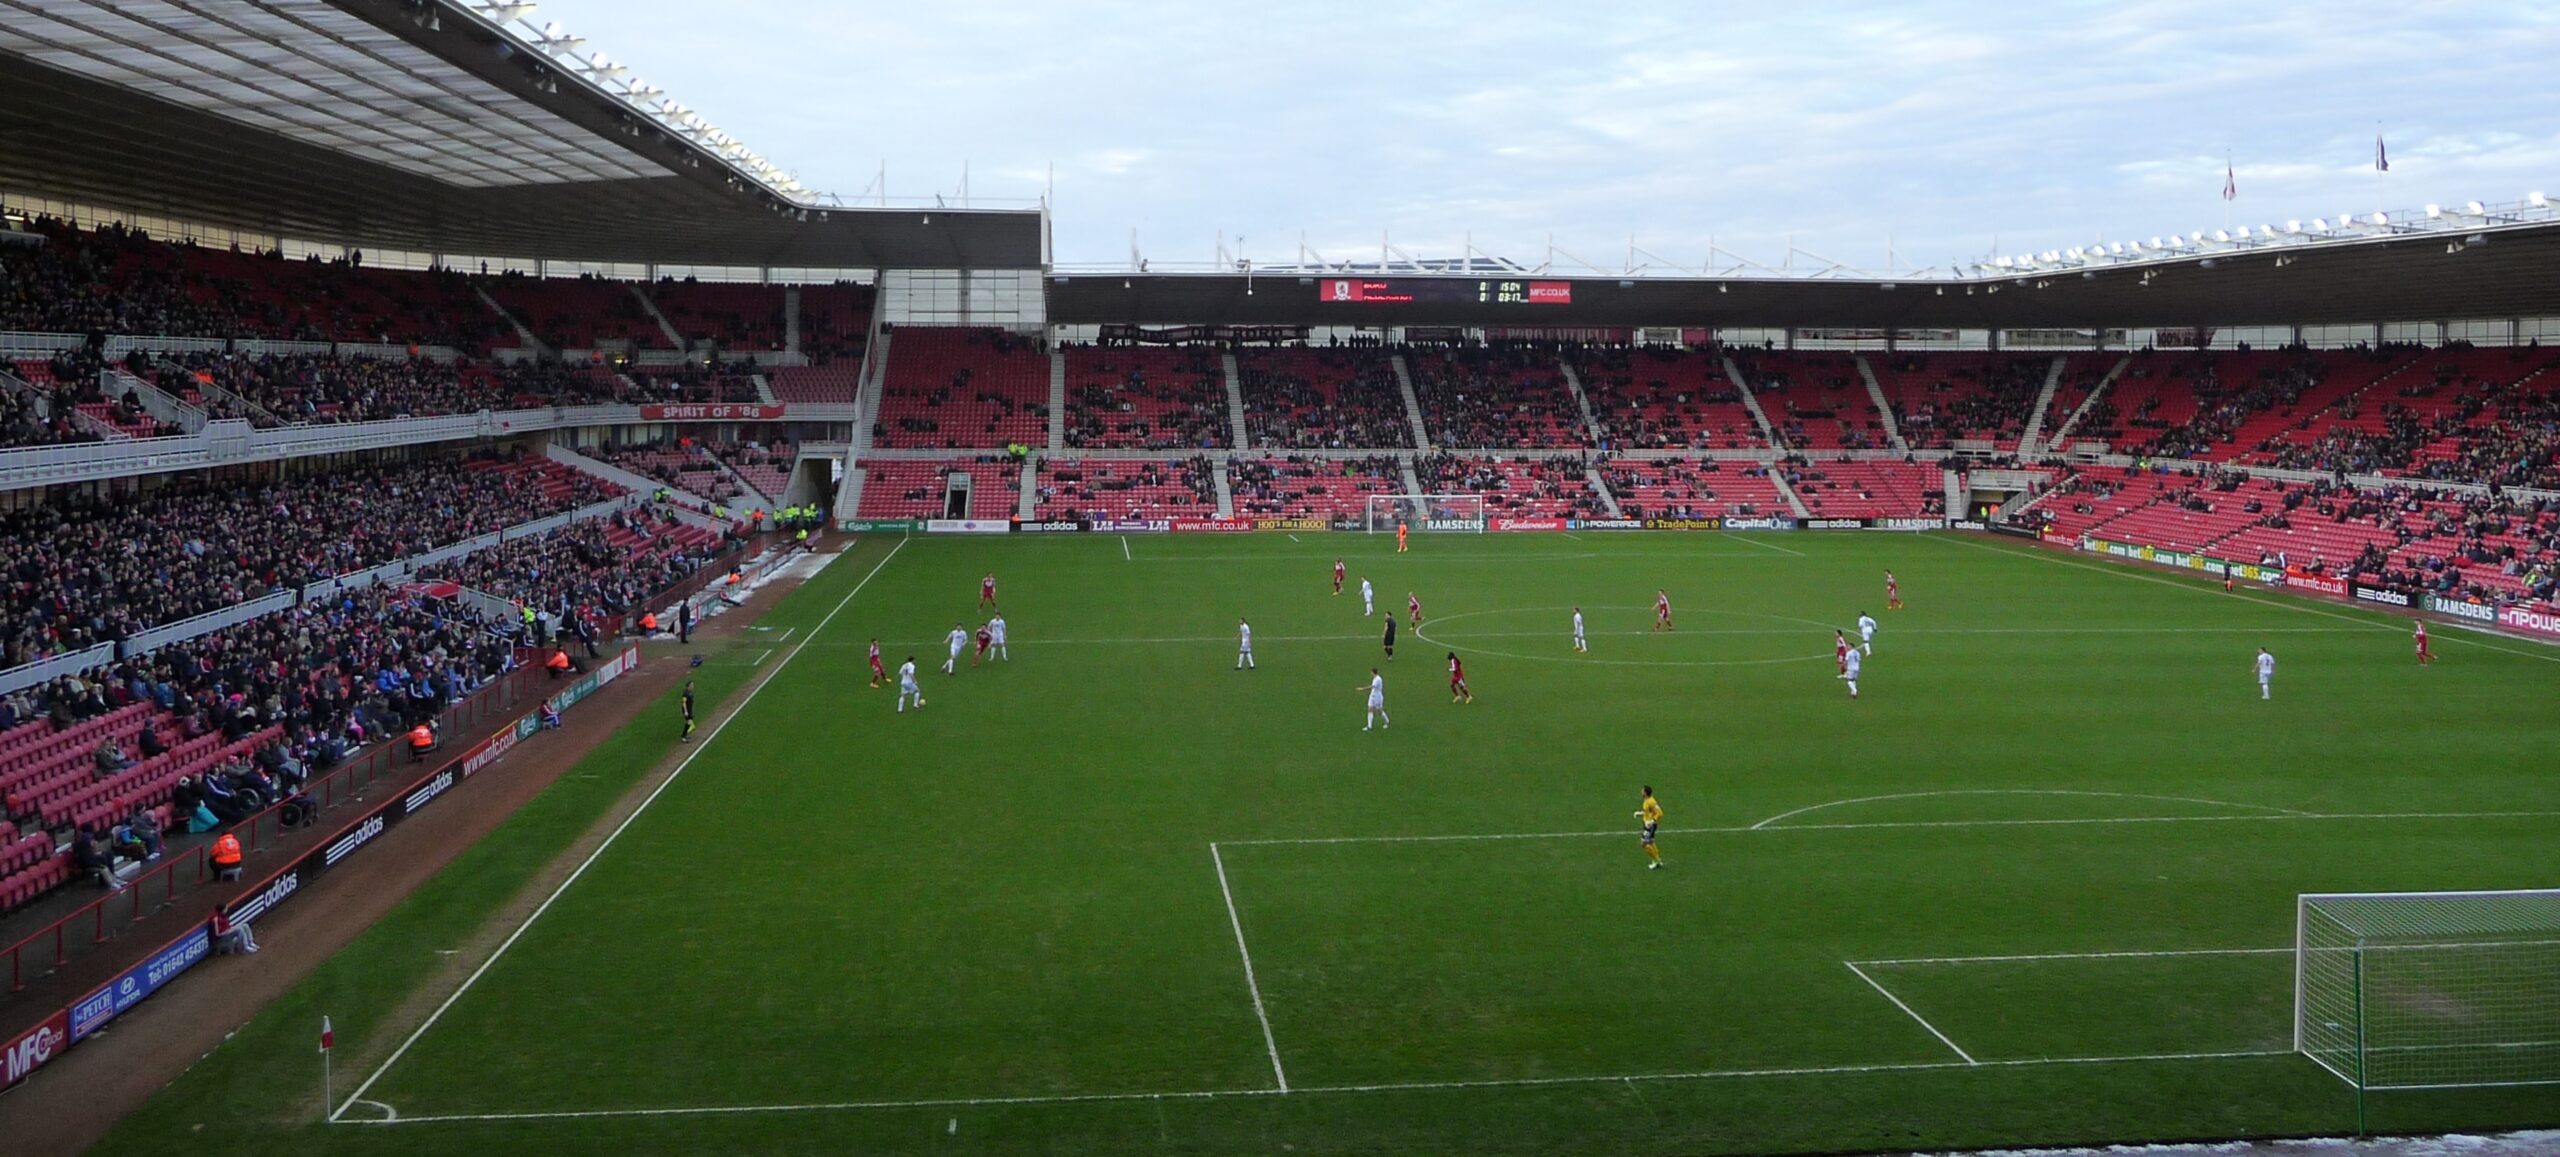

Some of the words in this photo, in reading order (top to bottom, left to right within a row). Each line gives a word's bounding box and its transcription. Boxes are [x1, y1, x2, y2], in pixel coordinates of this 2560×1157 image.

[1529, 288, 1570, 297] MFC.CO.UK
[663, 406, 706, 418] SPIRIT
[712, 406, 731, 417] OF
[738, 406, 760, 418] '86
[1043, 521, 1078, 531] adidas
[1176, 519, 1249, 530] www.mfc.co.uk
[1427, 519, 1484, 530] RAMSDENS
[1498, 519, 1557, 530] Budweiser
[1657, 519, 1709, 529] TradePoint
[1829, 519, 1861, 529] adidas
[1887, 518, 1943, 529] RAMSDENS
[1955, 521, 1985, 530] adidas
[2084, 538, 2126, 556] bet365.com
[2128, 545, 2174, 565] bet365.com
[2176, 553, 2224, 573] bet365.com
[2286, 574, 2344, 594] www.mfc.co.uk
[2375, 590, 2408, 606] adidas
[2435, 594, 2494, 621] RAMSDENS
[463, 726, 518, 776] www.mfc.co.uk
[429, 770, 453, 797] adidas
[354, 814, 384, 845] adidas
[264, 870, 298, 908] adidas
[163, 953, 185, 977] 01642
[83, 992, 111, 1020] PETCH
[8, 1026, 51, 1082] MFC
